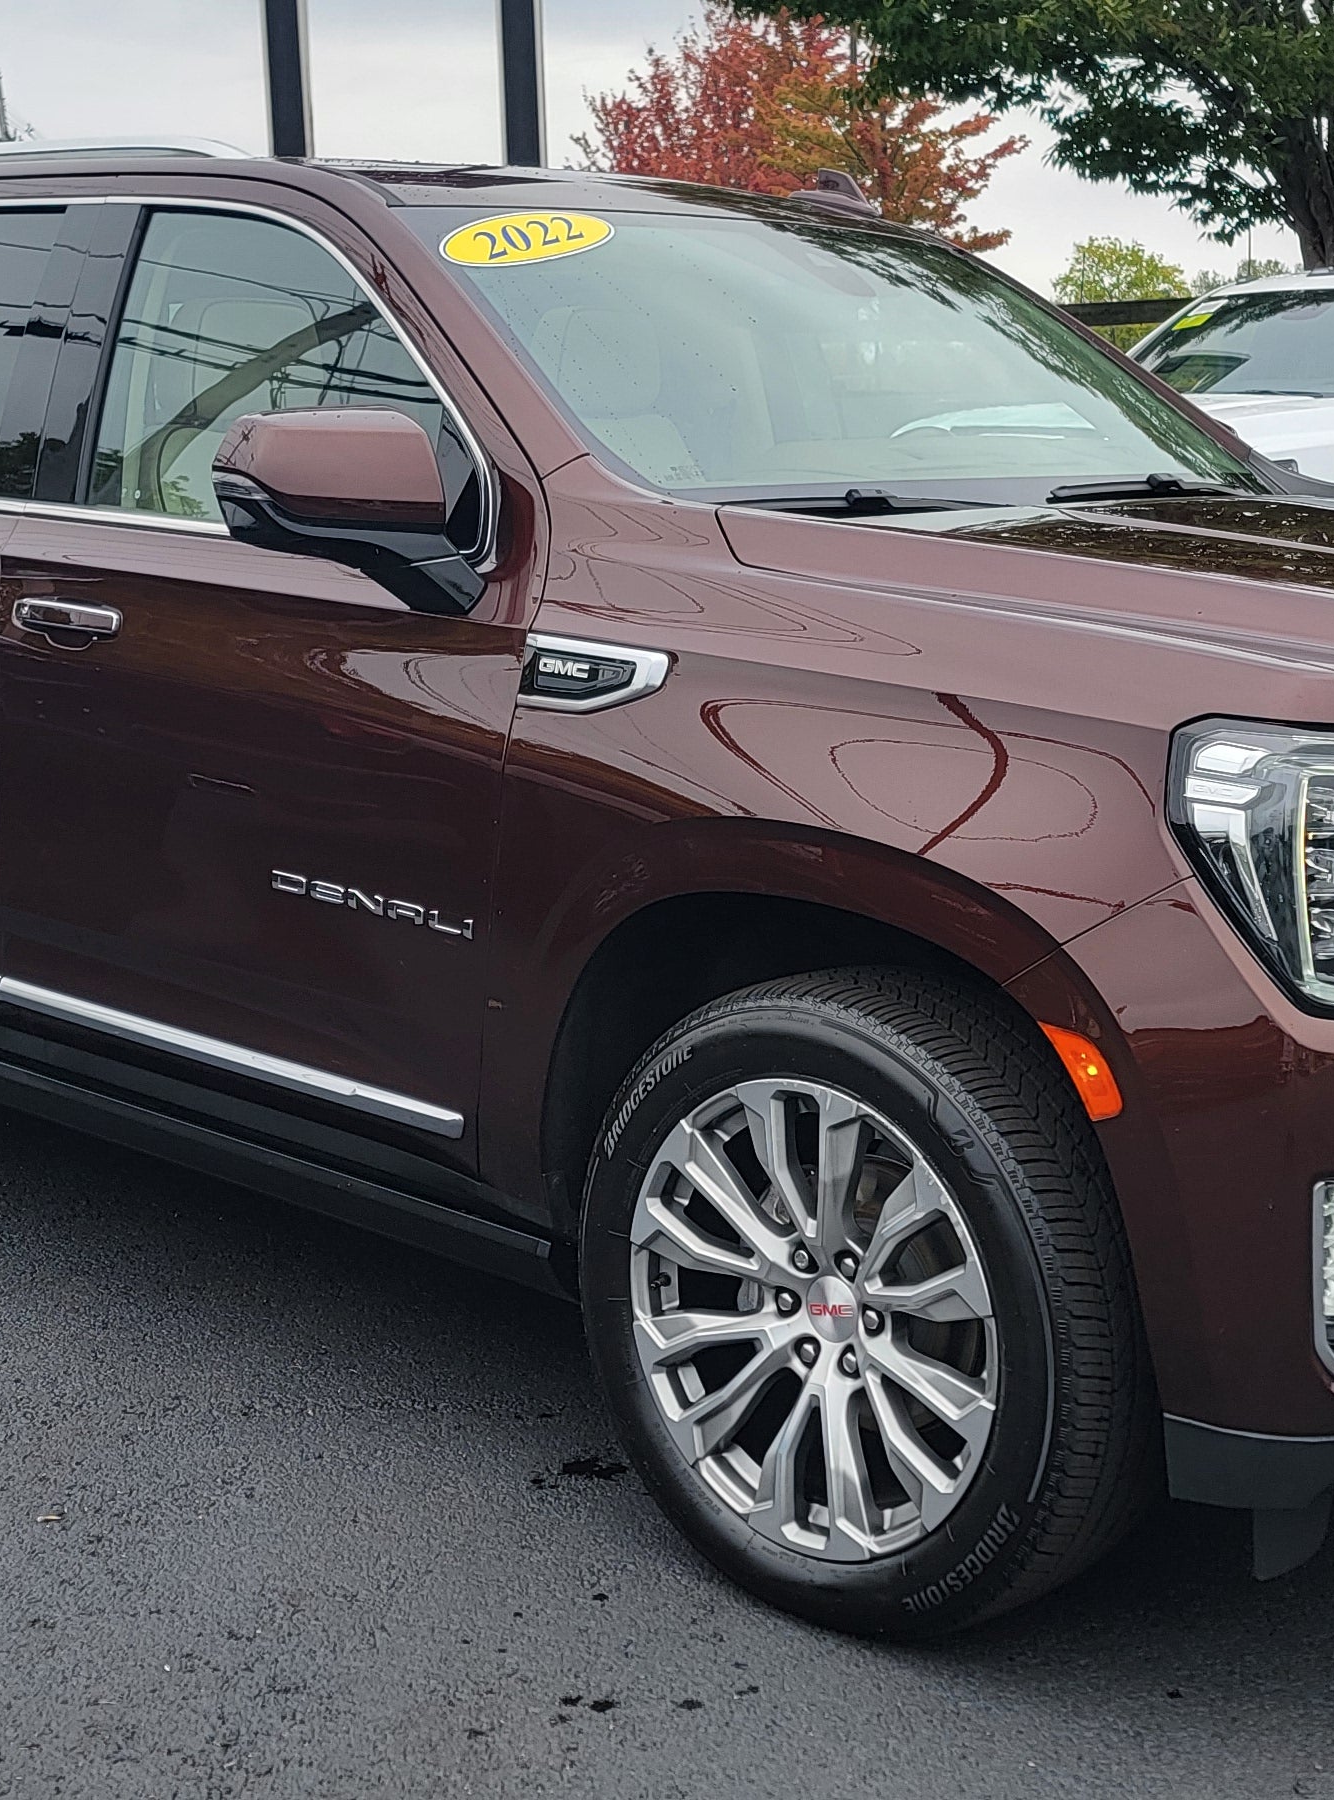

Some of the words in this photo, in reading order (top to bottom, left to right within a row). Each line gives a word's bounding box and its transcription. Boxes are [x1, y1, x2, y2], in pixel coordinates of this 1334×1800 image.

[473, 216, 585, 261] 2022
[538, 657, 591, 679] GMC
[271, 869, 474, 941] DENALI
[603, 1045, 693, 1161] BRIDGESTONE
[809, 1303, 854, 1318] GMC
[901, 1502, 1021, 1614] BRIDGESTONE
